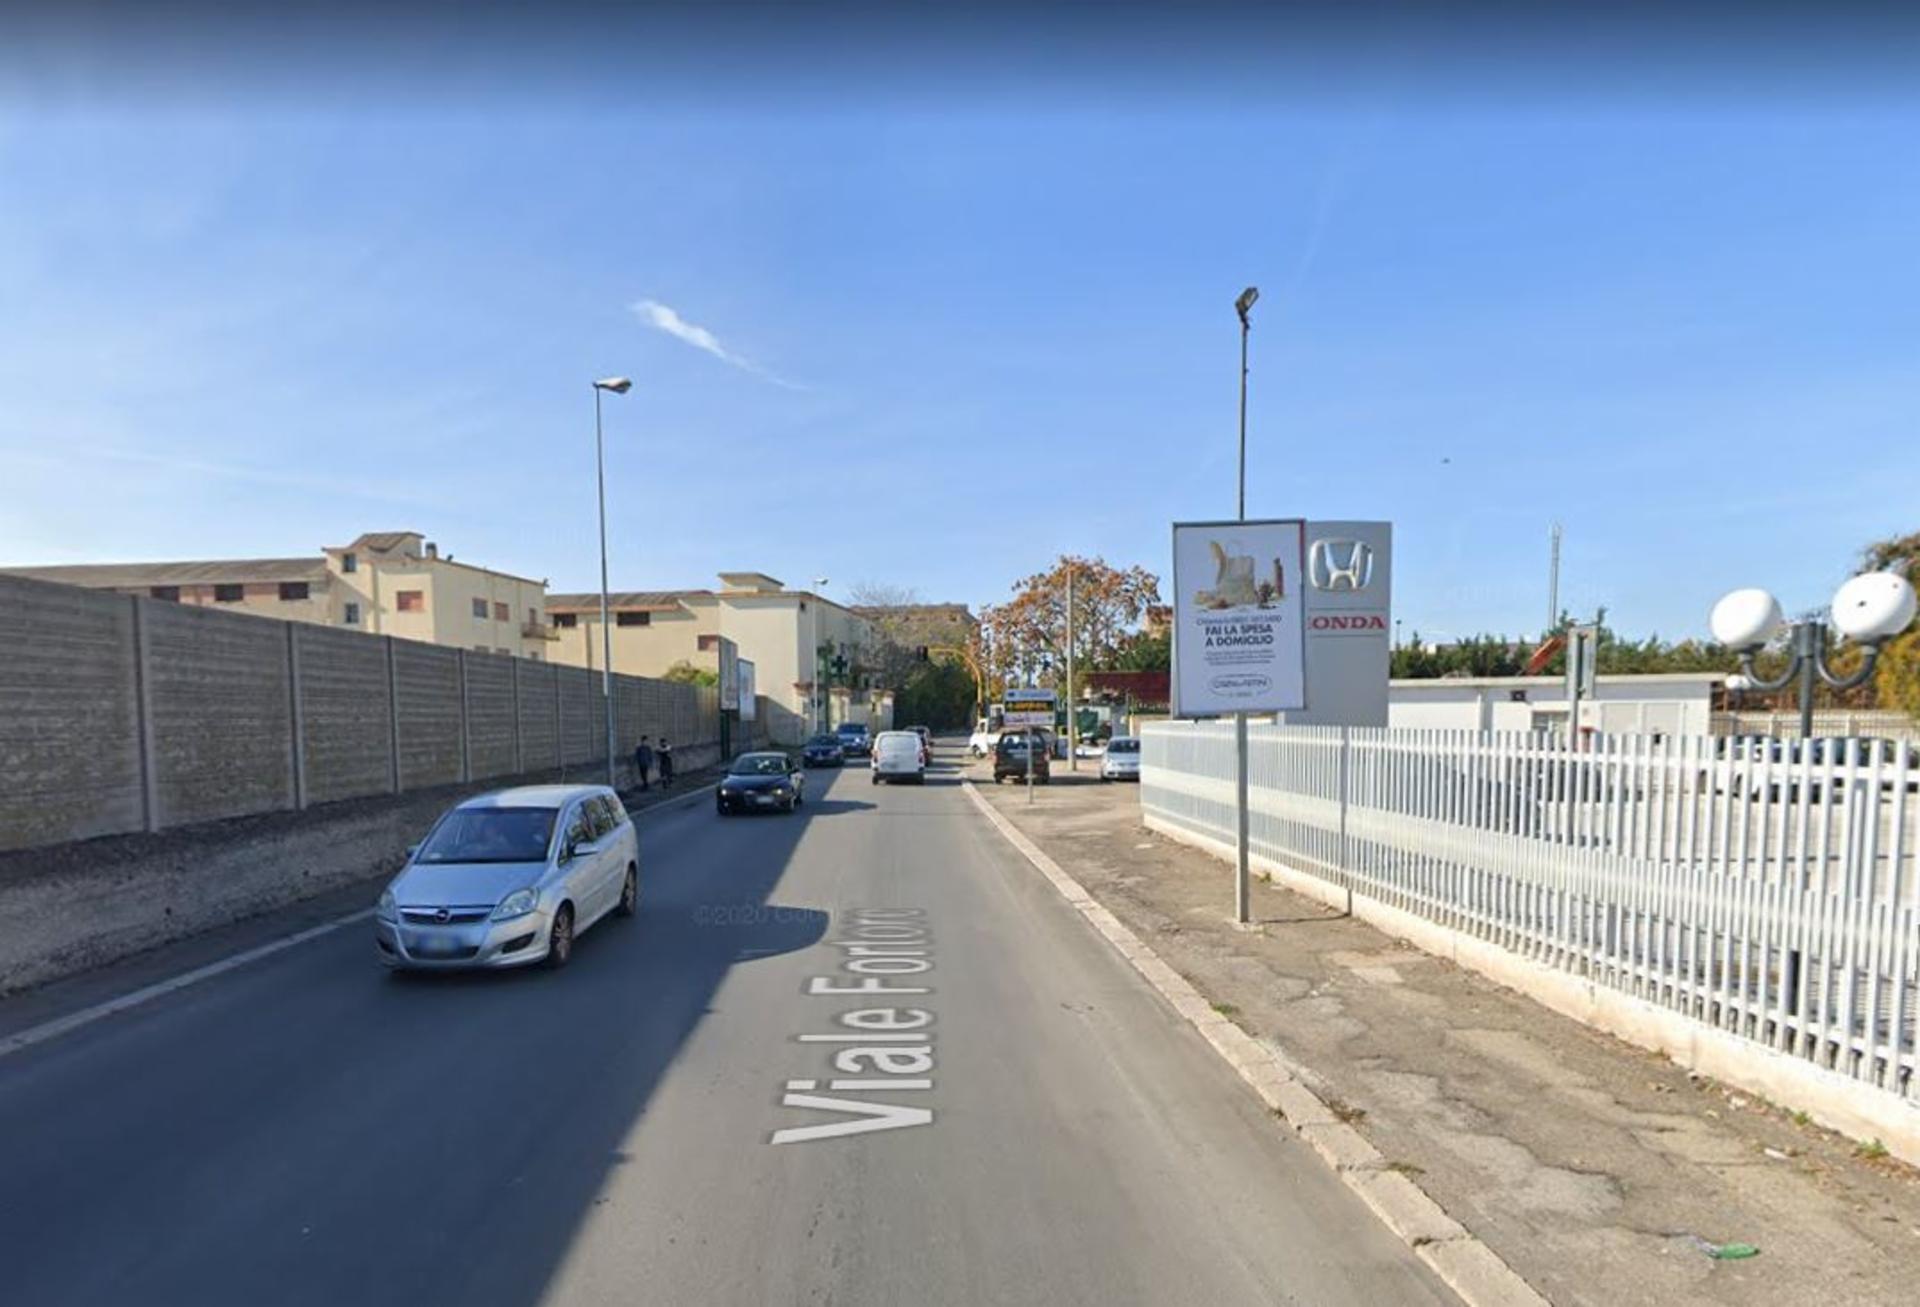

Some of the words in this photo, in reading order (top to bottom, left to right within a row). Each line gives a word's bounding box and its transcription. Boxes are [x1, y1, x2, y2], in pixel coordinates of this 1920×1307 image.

[1307, 616, 1385, 630] ONDA
[1205, 626, 1222, 635] FAI
[1224, 626, 1238, 635] LA
[1205, 637, 1214, 647] A
[1216, 634, 1274, 646] DOMICILIO
